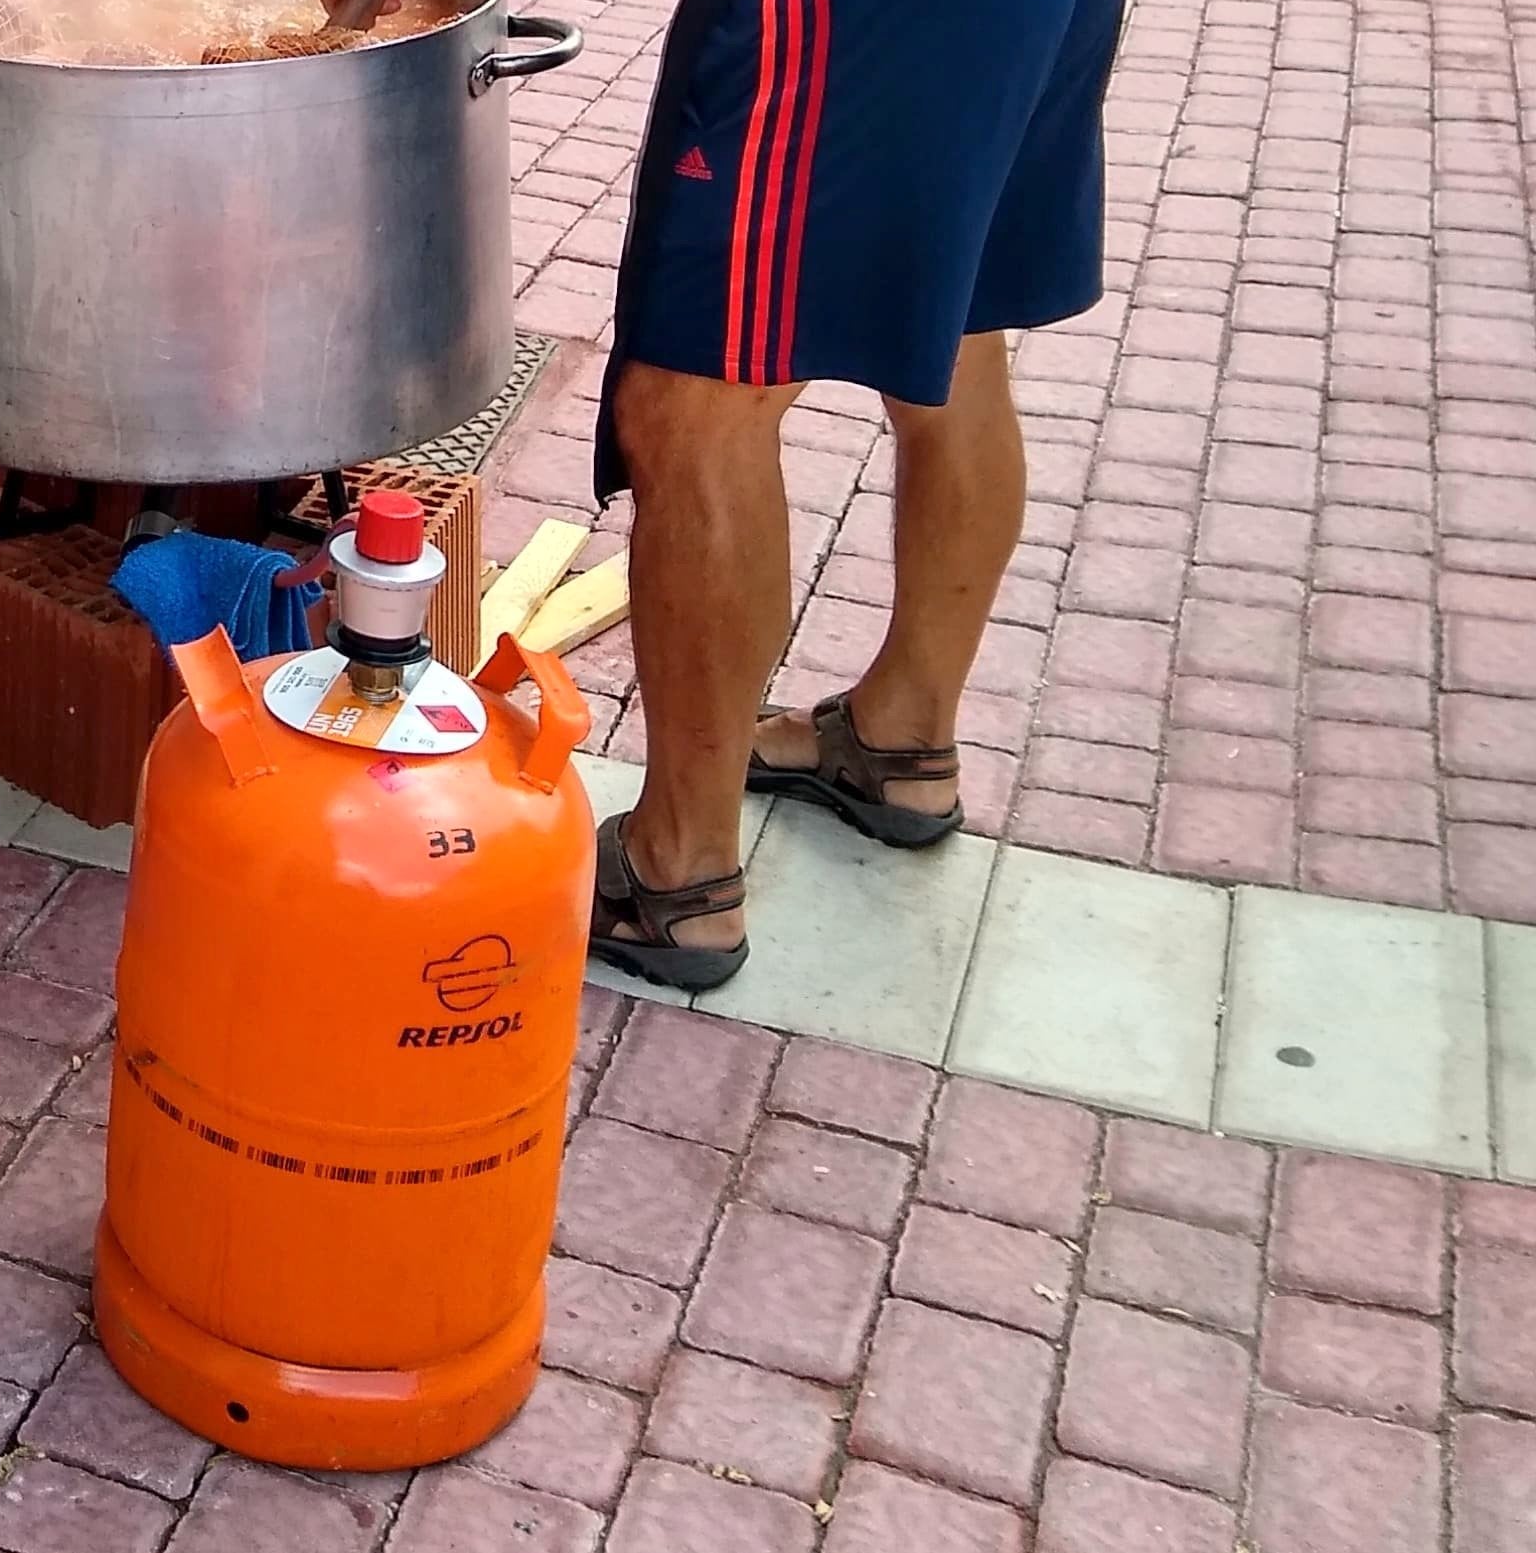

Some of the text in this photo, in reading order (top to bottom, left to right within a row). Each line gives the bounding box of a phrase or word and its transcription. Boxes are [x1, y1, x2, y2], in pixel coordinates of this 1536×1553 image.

[305, 712, 334, 735] UN
[327, 705, 363, 738] 1965
[426, 827, 476, 859] 33
[398, 1013, 523, 1047] REPSOL
